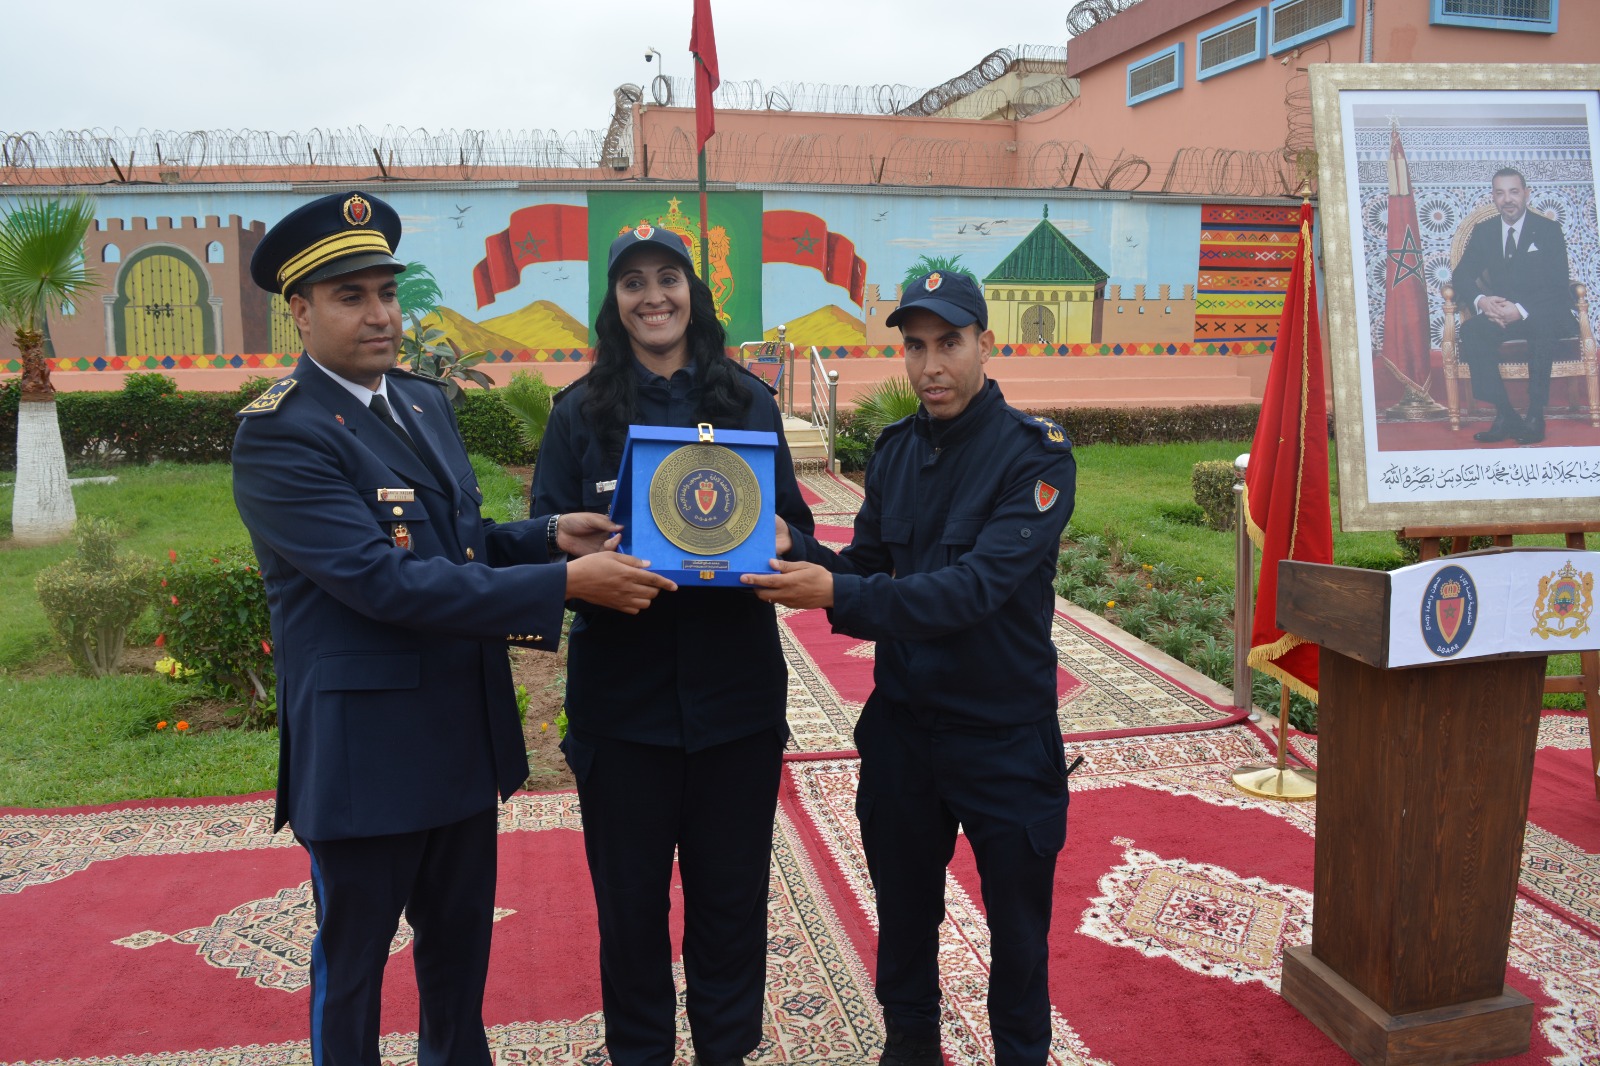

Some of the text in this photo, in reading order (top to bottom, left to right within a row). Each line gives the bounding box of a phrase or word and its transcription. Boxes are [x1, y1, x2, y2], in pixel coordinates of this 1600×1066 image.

[1380, 463, 1402, 490] الله
[1435, 463, 1484, 488] السادس
[1486, 461, 1510, 485] محمد
[1509, 463, 1540, 486] الملك
